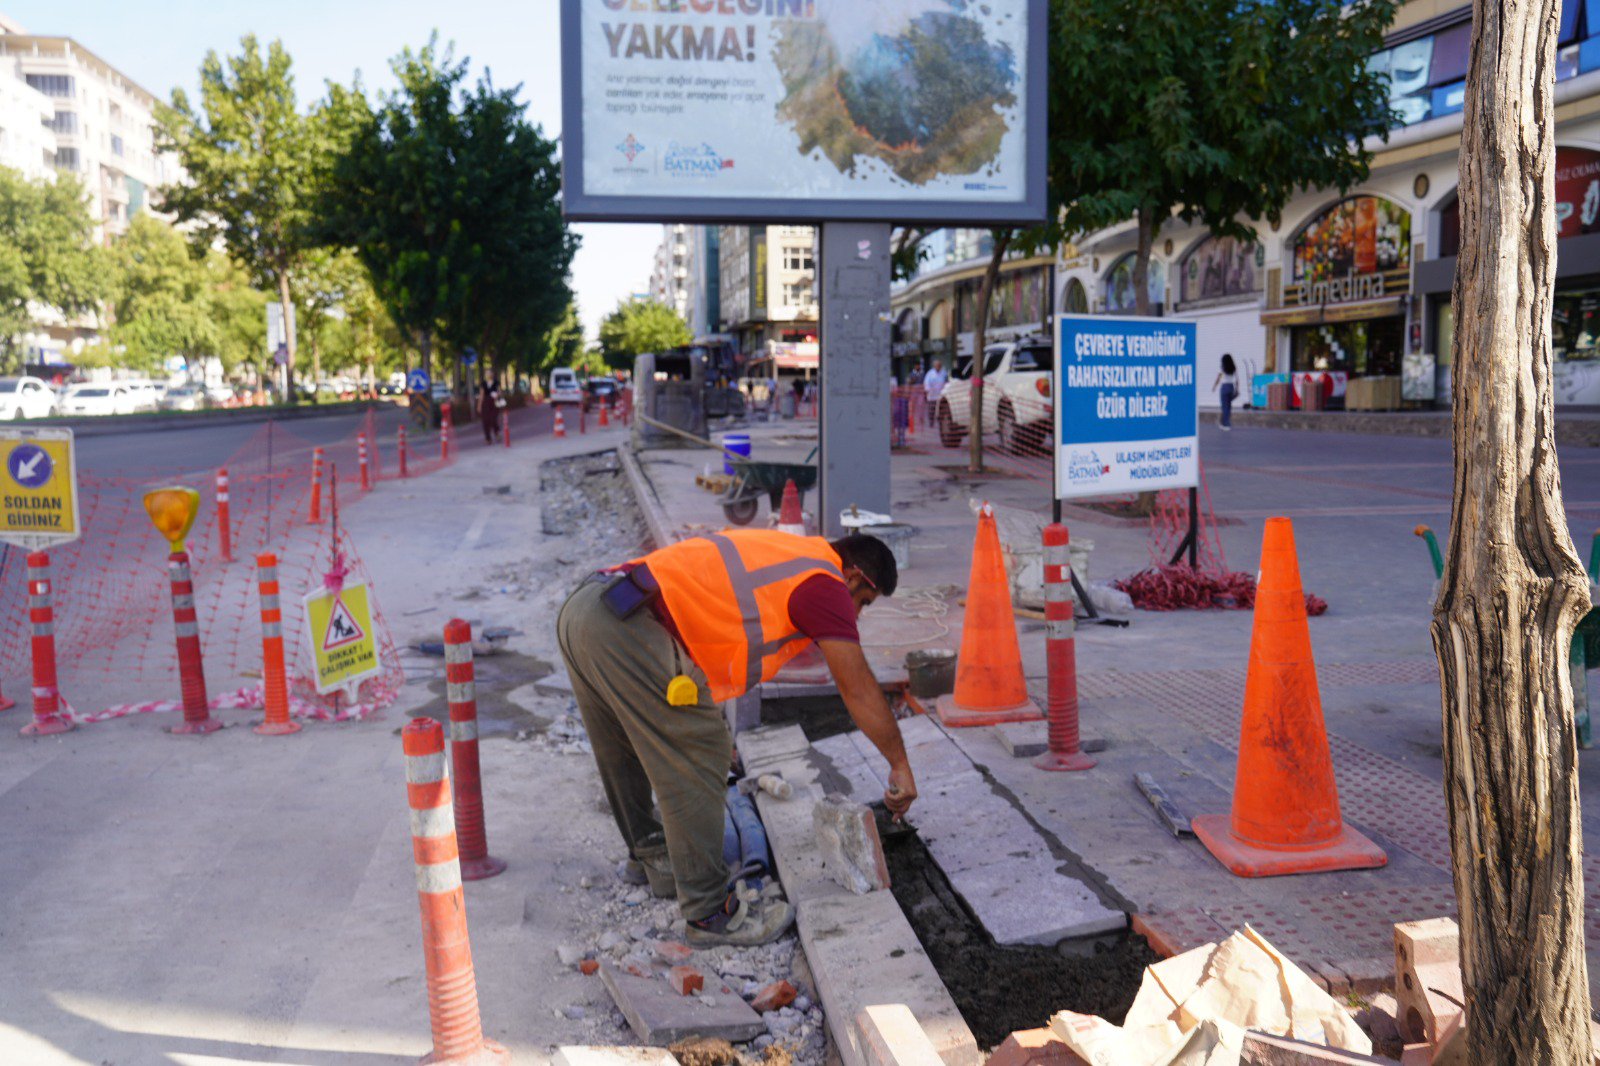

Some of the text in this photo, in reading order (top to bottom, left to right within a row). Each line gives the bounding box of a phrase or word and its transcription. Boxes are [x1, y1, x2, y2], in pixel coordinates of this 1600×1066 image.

[601, 23, 756, 63] YAKMA!
[664, 156, 723, 172] BATMAN
[1298, 266, 1385, 305] elmedina
[1074, 330, 1187, 362] ÇEVREYE VERDİĞİMİZ
[1067, 363, 1193, 388] RAHATSIZLIKTAN DOLAYI
[1096, 390, 1168, 419] ÖZÜR DİLERİZ
[1115, 444, 1192, 465] ULAŞIM HİZMETLERİ
[1068, 463, 1104, 480] BATMAN
[1129, 461, 1179, 480] MÜDÜRLÜĞÜ
[4, 495, 62, 510] SOLDAN
[7, 511, 62, 527] GİDİNİZ
[358, 650, 373, 662] VAR
